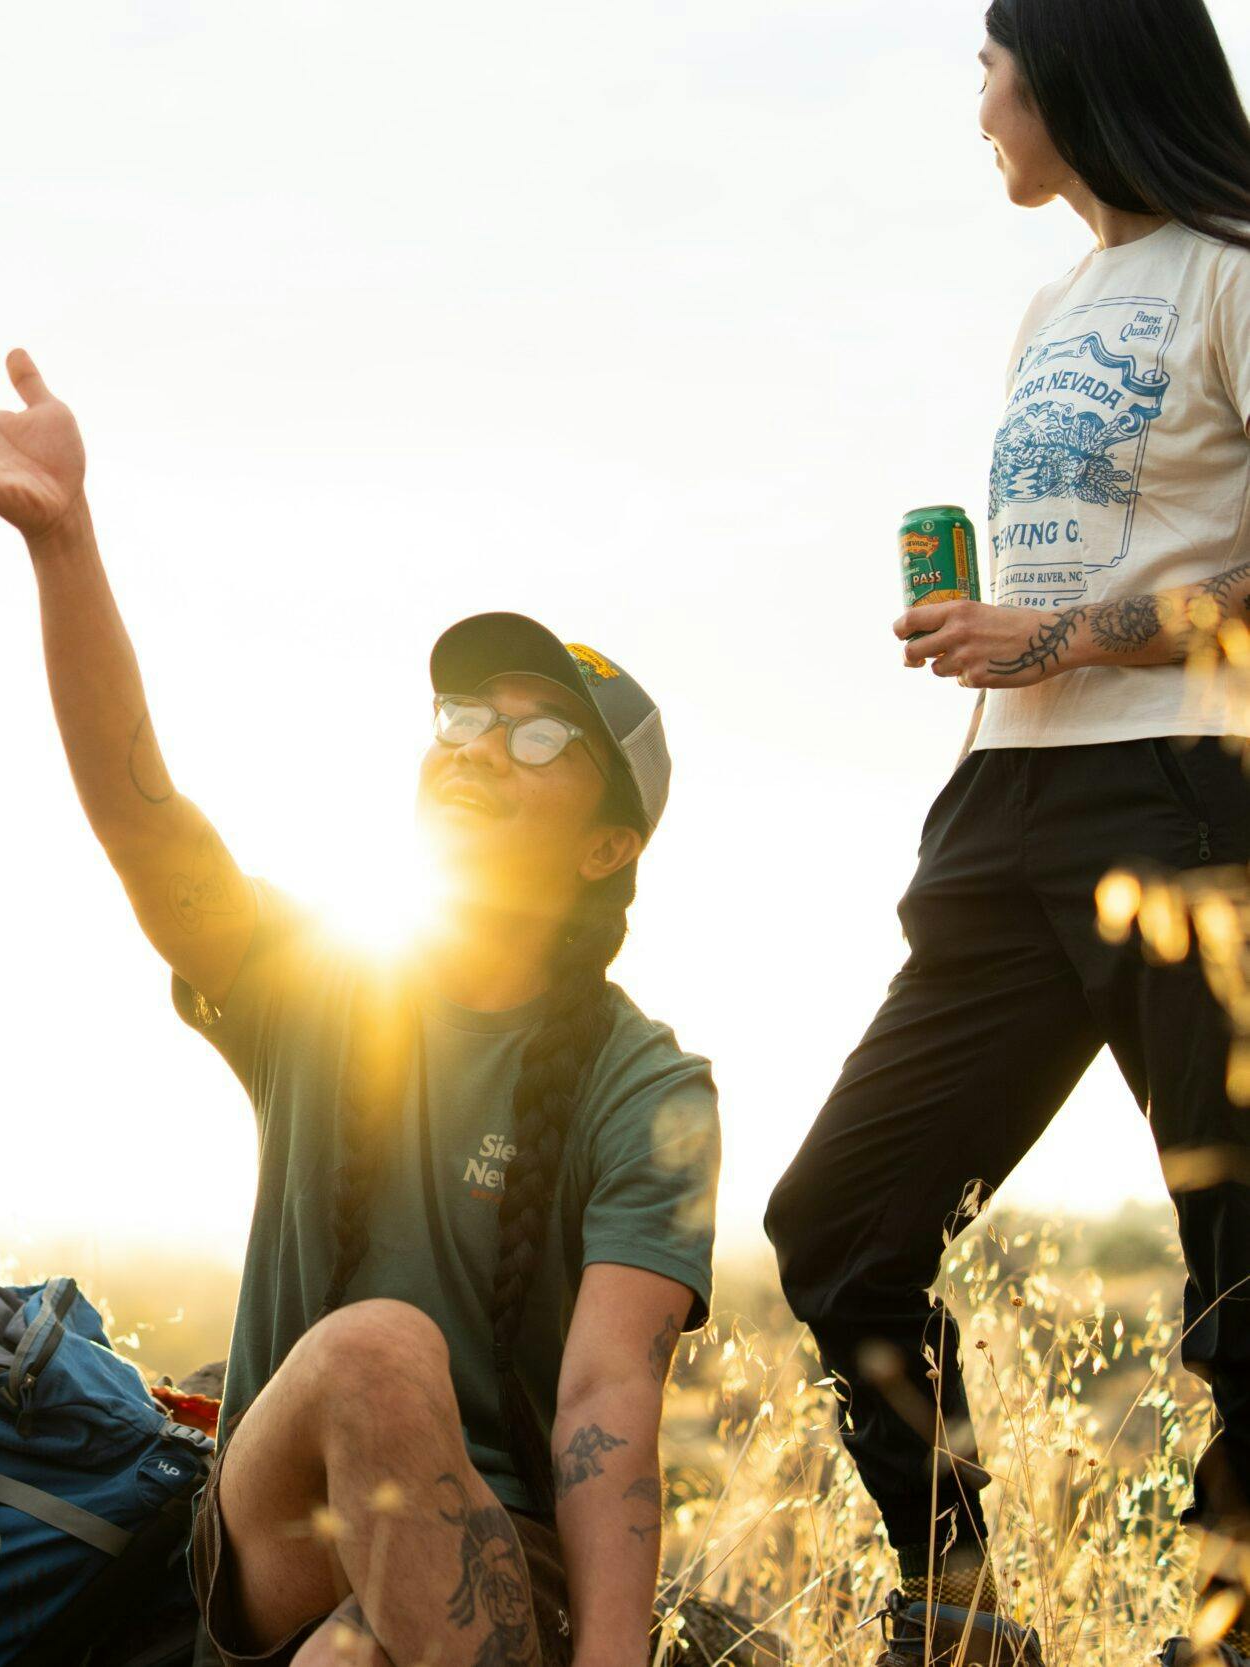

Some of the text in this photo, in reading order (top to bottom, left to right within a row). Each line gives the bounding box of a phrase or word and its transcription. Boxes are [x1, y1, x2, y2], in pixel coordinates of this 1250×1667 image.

[1133, 310, 1163, 325] Finest
[1119, 323, 1163, 342] Quality
[1007, 368, 1124, 411] RRA NEVADA
[913, 570, 942, 587] PASS
[1010, 572, 1035, 585] MILLS
[1037, 571, 1066, 583] RIVER,
[1068, 571, 1083, 582] NC
[1018, 597, 1046, 606] 1980
